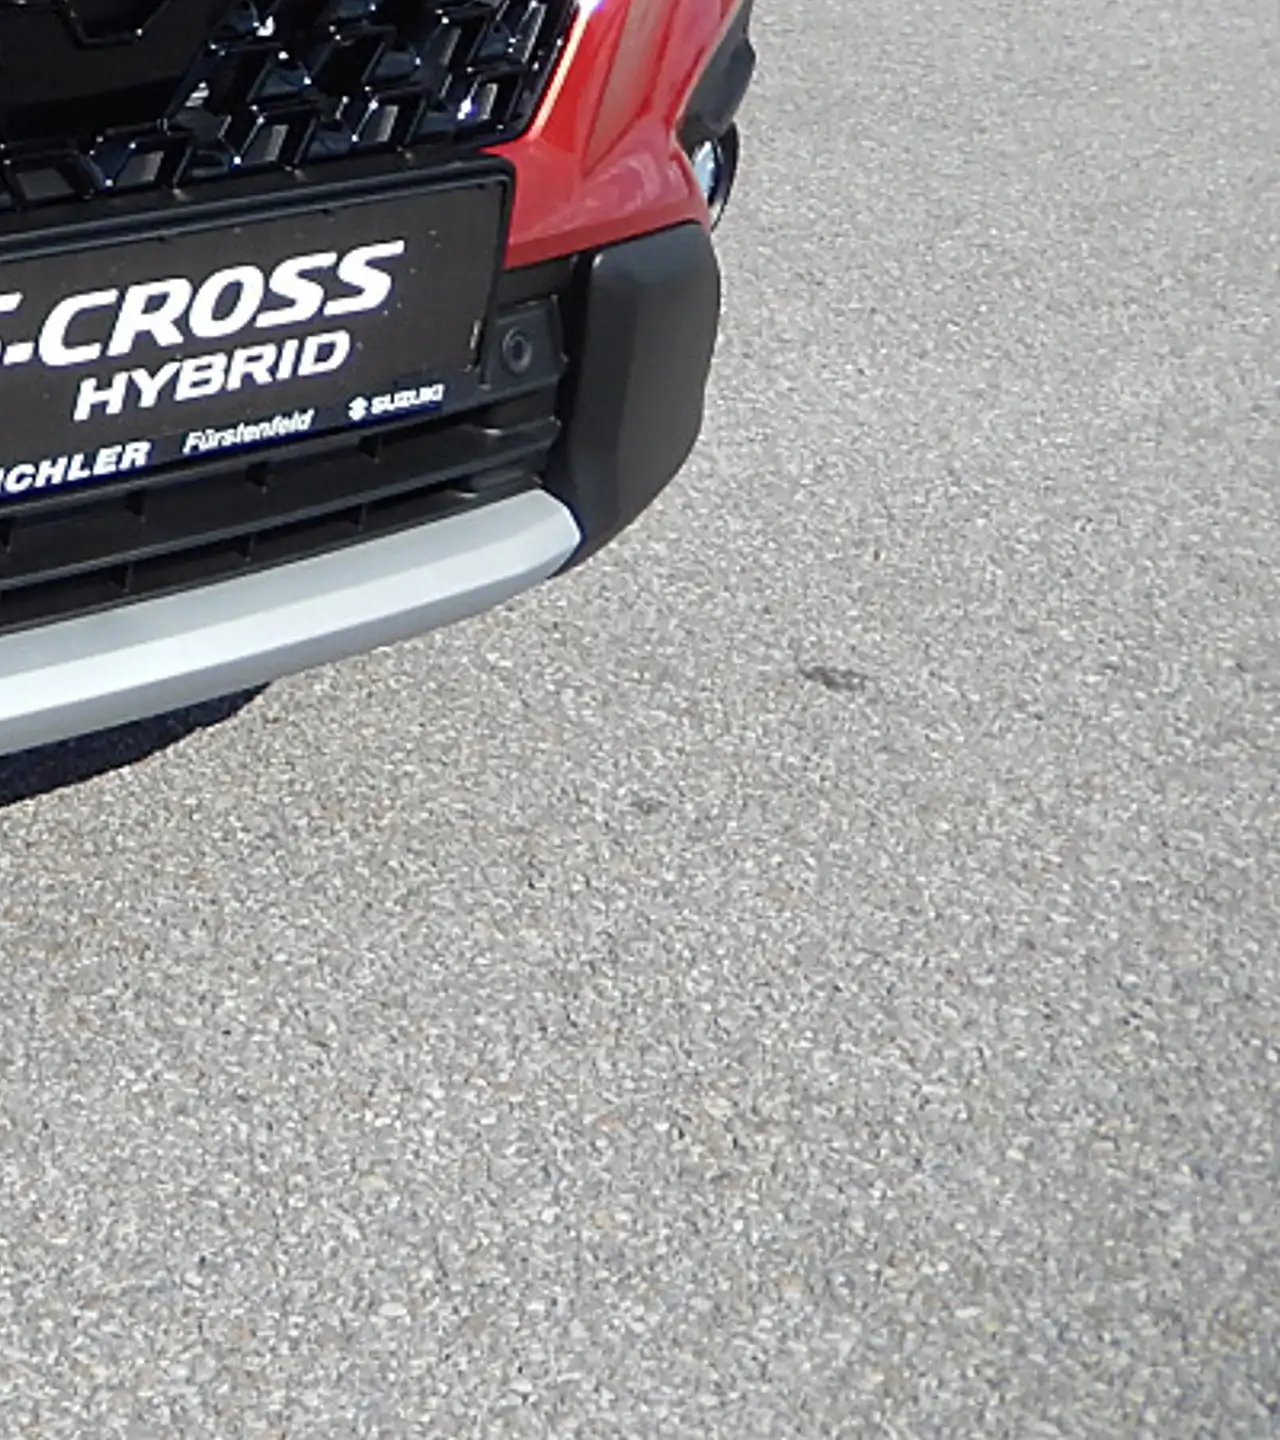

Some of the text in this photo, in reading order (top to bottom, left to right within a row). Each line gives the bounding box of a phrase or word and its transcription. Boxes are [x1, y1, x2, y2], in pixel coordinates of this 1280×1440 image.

[72, 329, 351, 422] HYBRID
[182, 409, 315, 455] Fürstenfeld
[370, 383, 445, 414] SUZUKI
